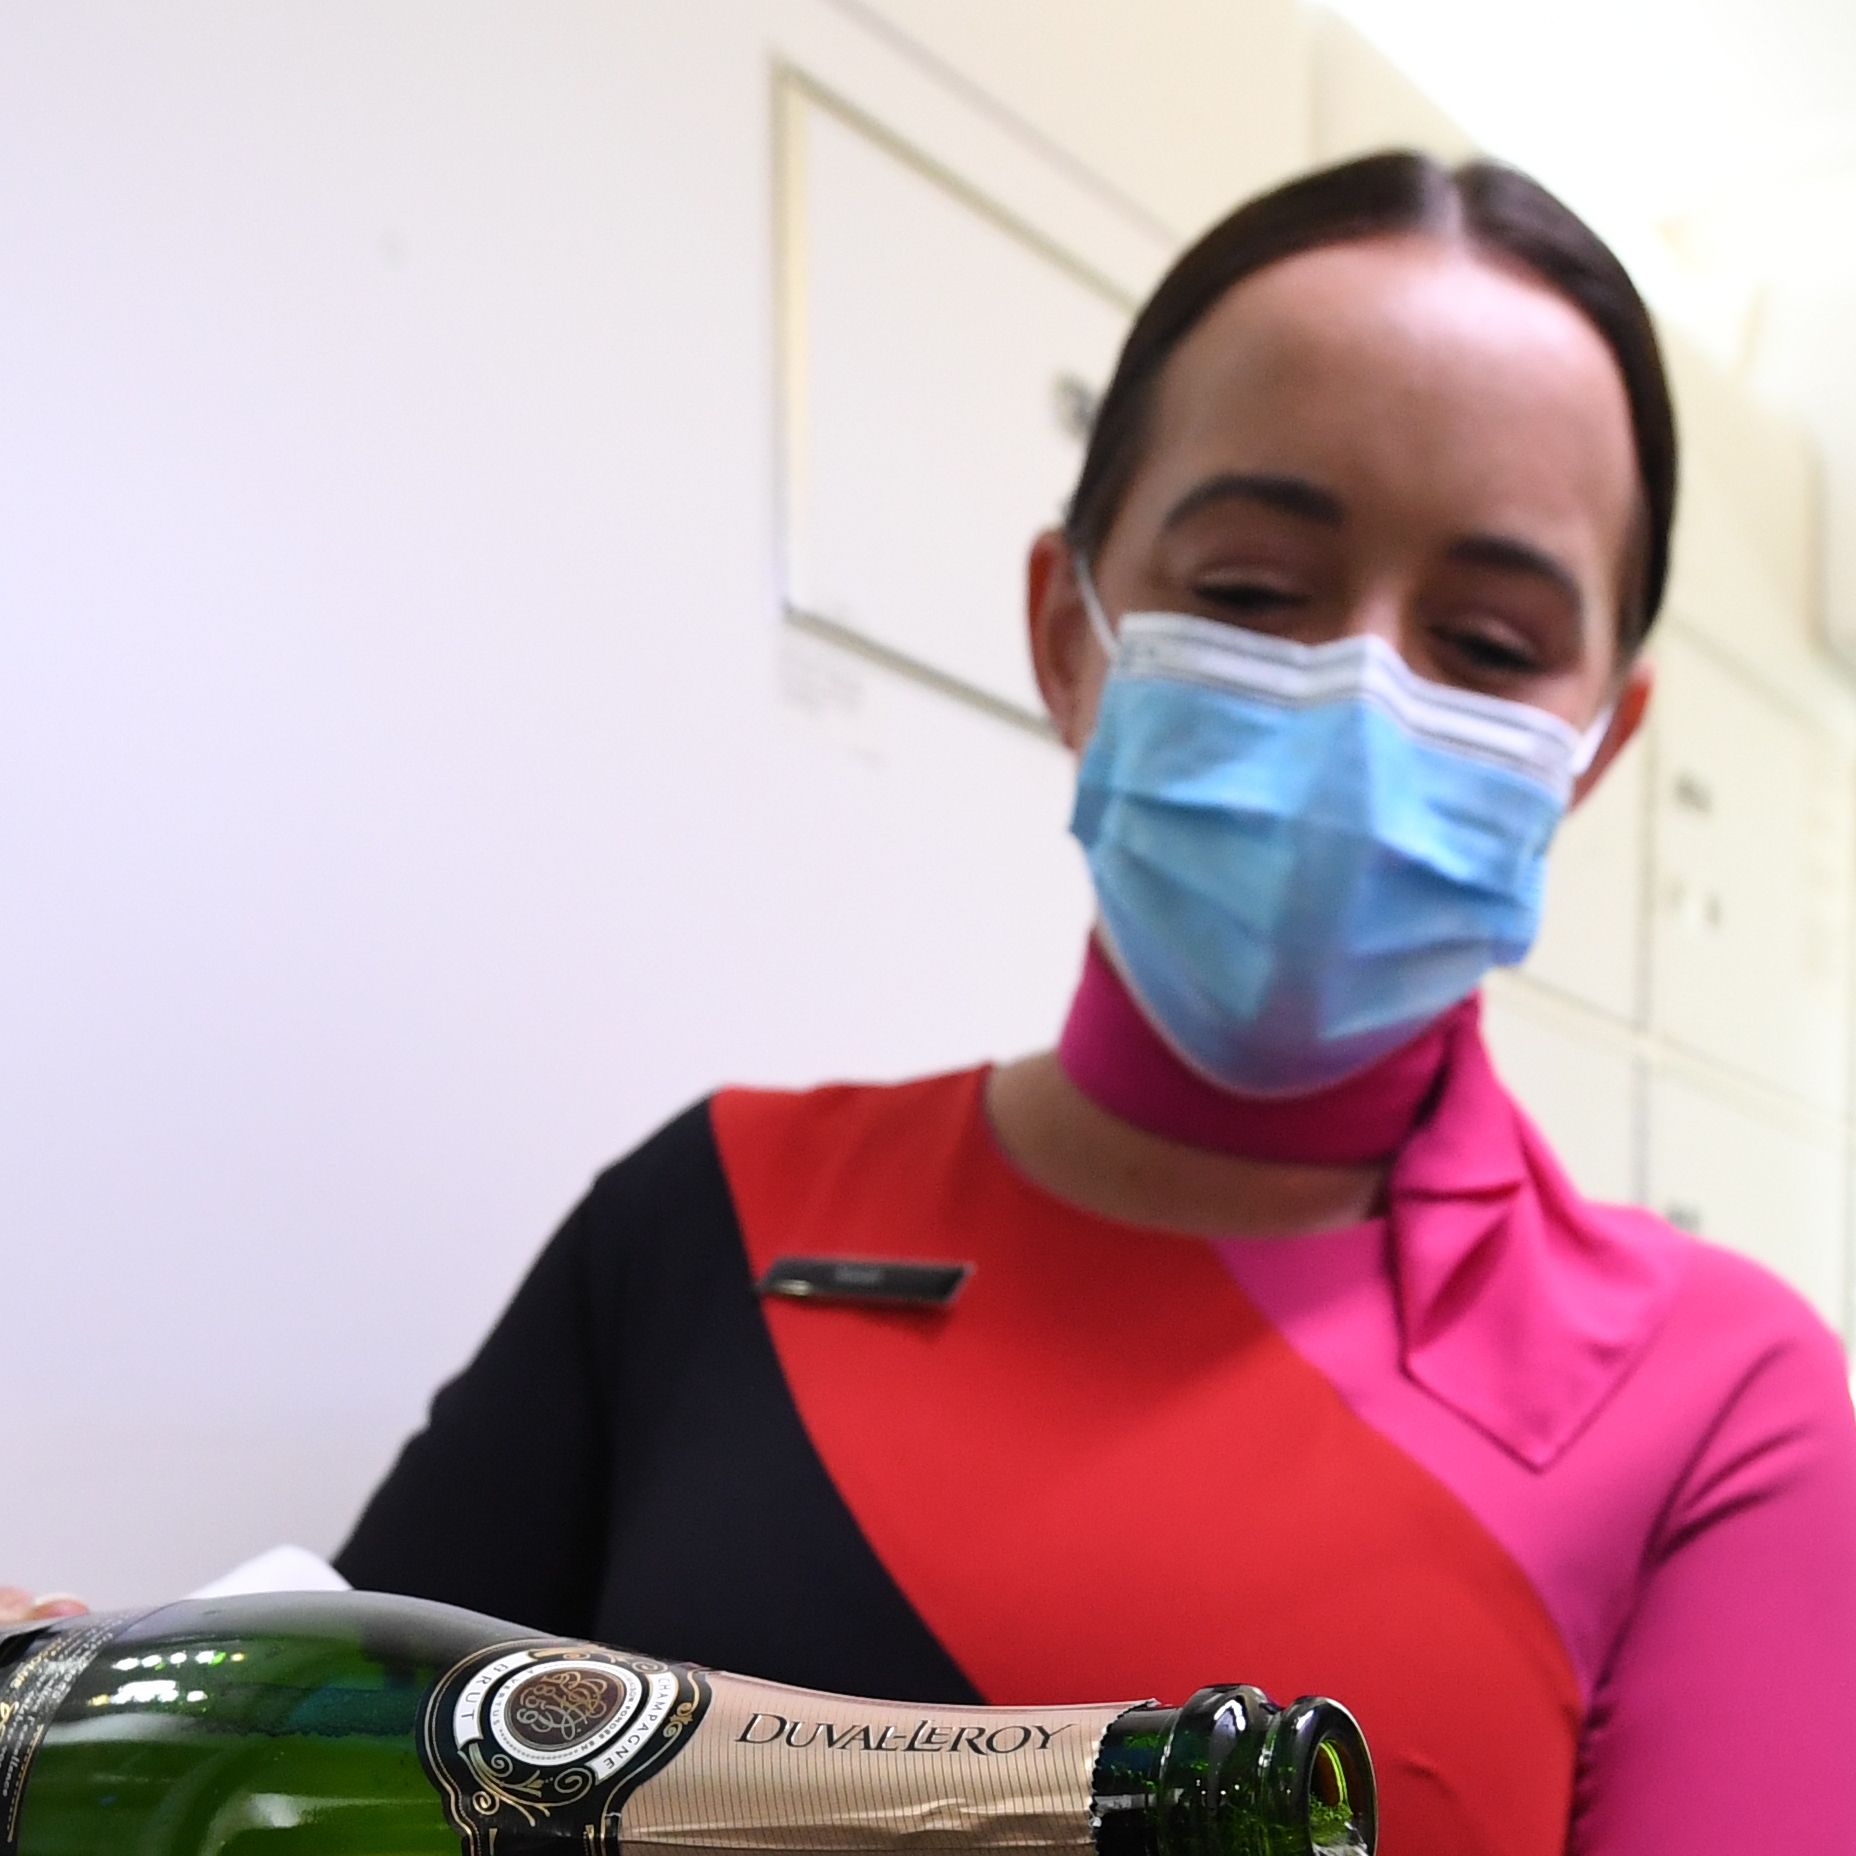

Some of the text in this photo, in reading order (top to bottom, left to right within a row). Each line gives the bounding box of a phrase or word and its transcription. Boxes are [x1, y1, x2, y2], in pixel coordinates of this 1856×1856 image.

[460, 1663, 508, 1721] BRUT
[602, 1676, 671, 1771] CHAMPAGNE
[735, 1712, 1078, 1756] DUVAL-LEROY
